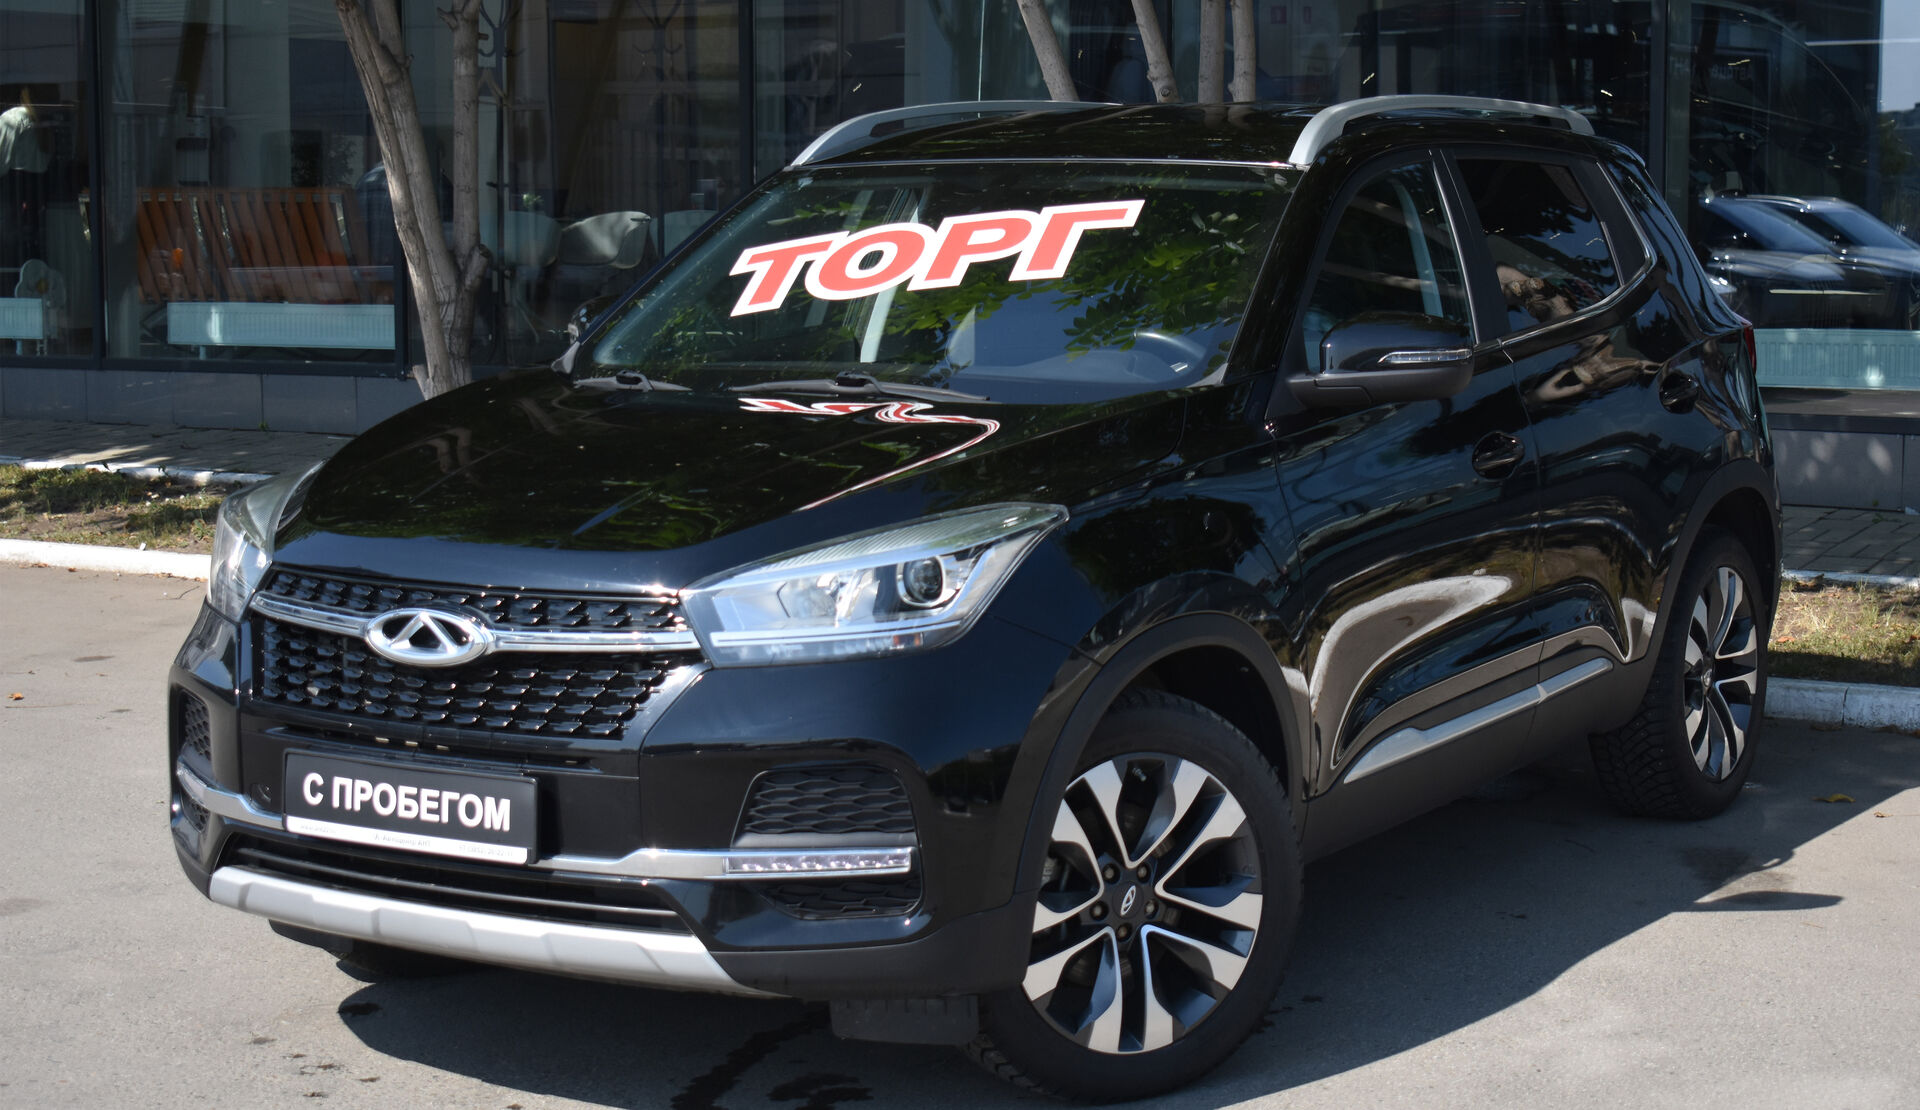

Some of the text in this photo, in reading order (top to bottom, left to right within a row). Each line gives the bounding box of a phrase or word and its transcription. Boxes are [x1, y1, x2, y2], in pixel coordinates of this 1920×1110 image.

[729, 199, 1146, 317] ТОРГ
[303, 772, 511, 832] С ПРОБЕГОМ
